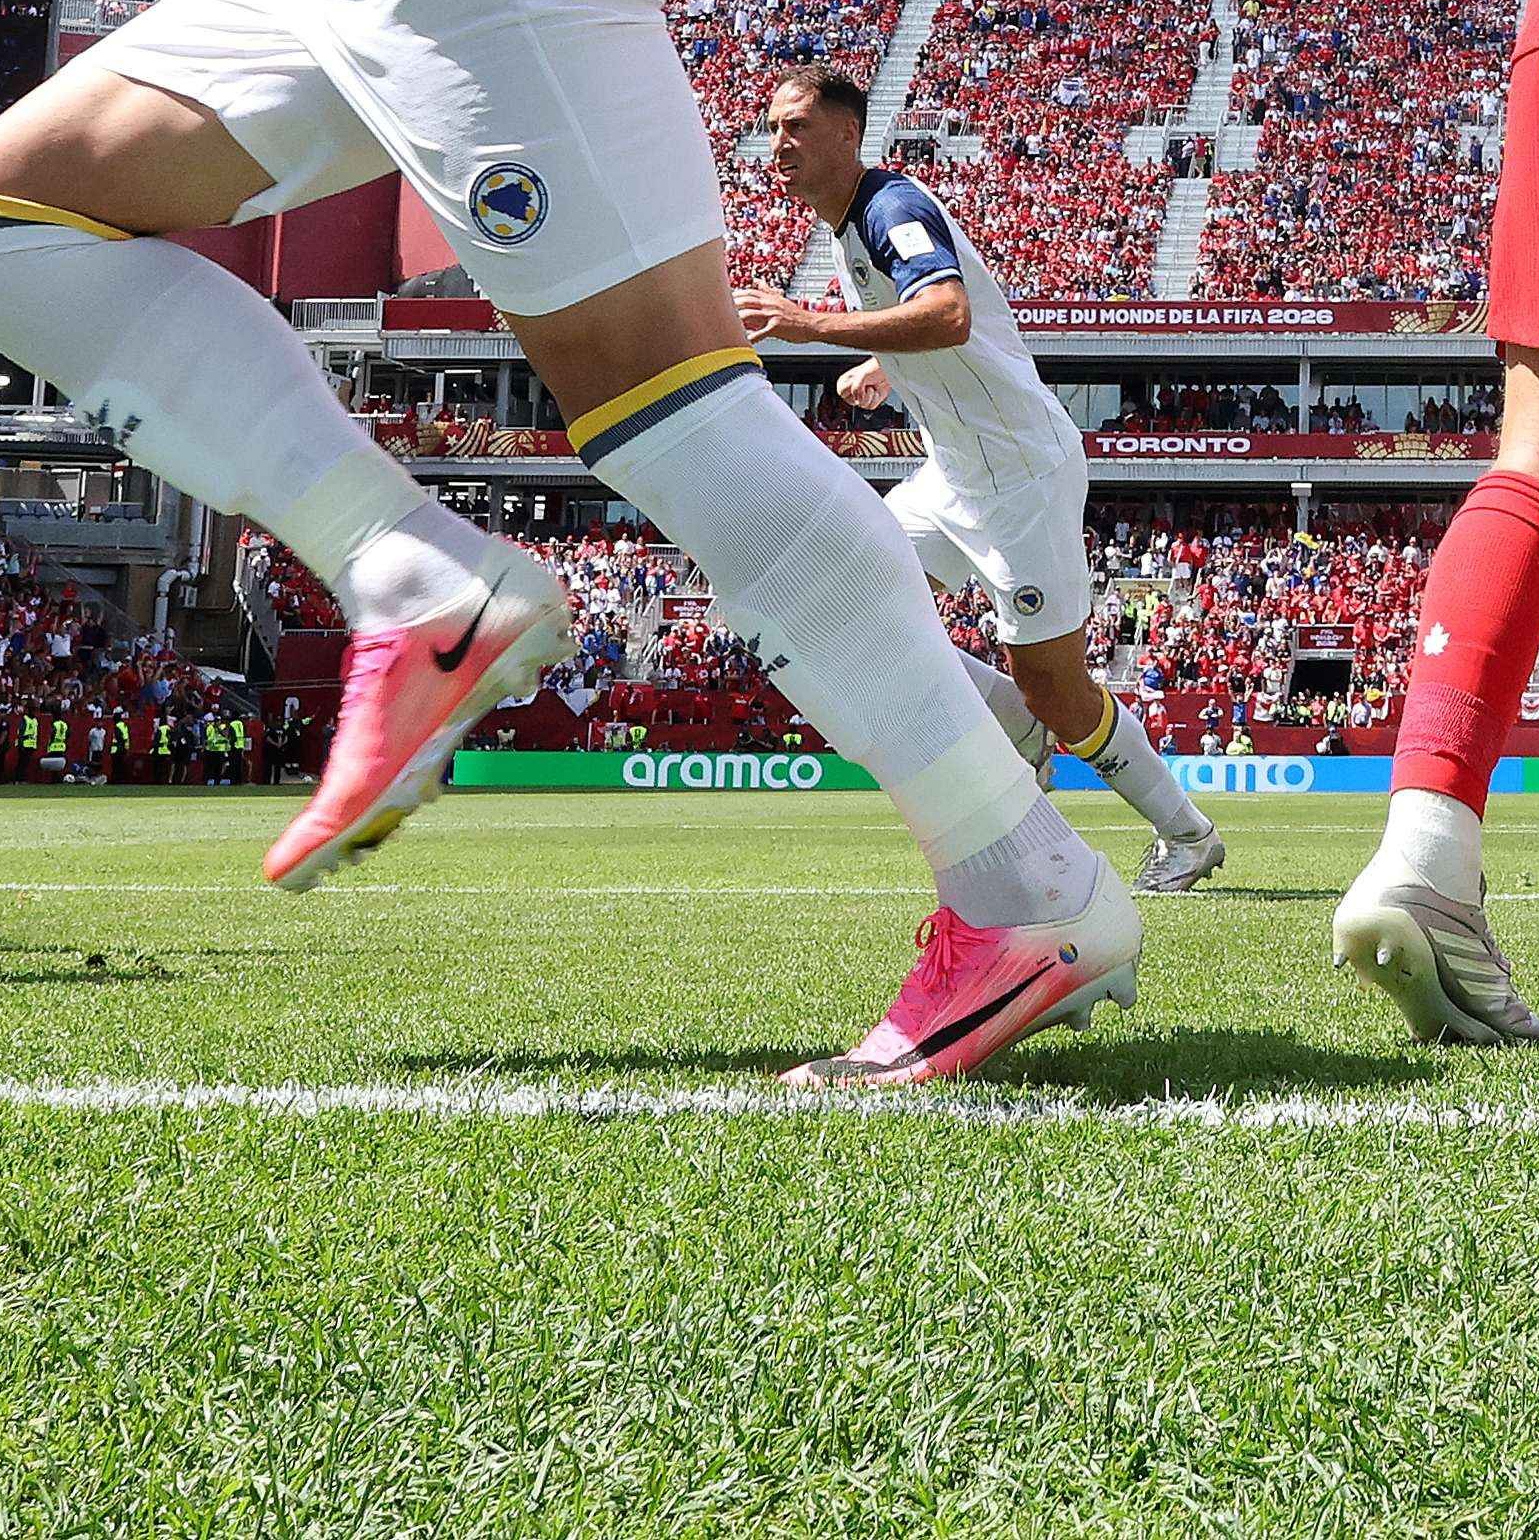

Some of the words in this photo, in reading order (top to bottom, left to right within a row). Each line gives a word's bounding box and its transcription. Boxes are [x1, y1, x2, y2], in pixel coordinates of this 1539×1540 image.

[1070, 308, 1096, 324] DU
[1100, 308, 1167, 324] MONDE
[1169, 308, 1191, 324] DE
[1195, 308, 1220, 324] LA
[1223, 308, 1264, 324] FIFA
[1266, 308, 1334, 325] 2026
[1095, 437, 1252, 453] TORONTO
[622, 753, 823, 789] aramco
